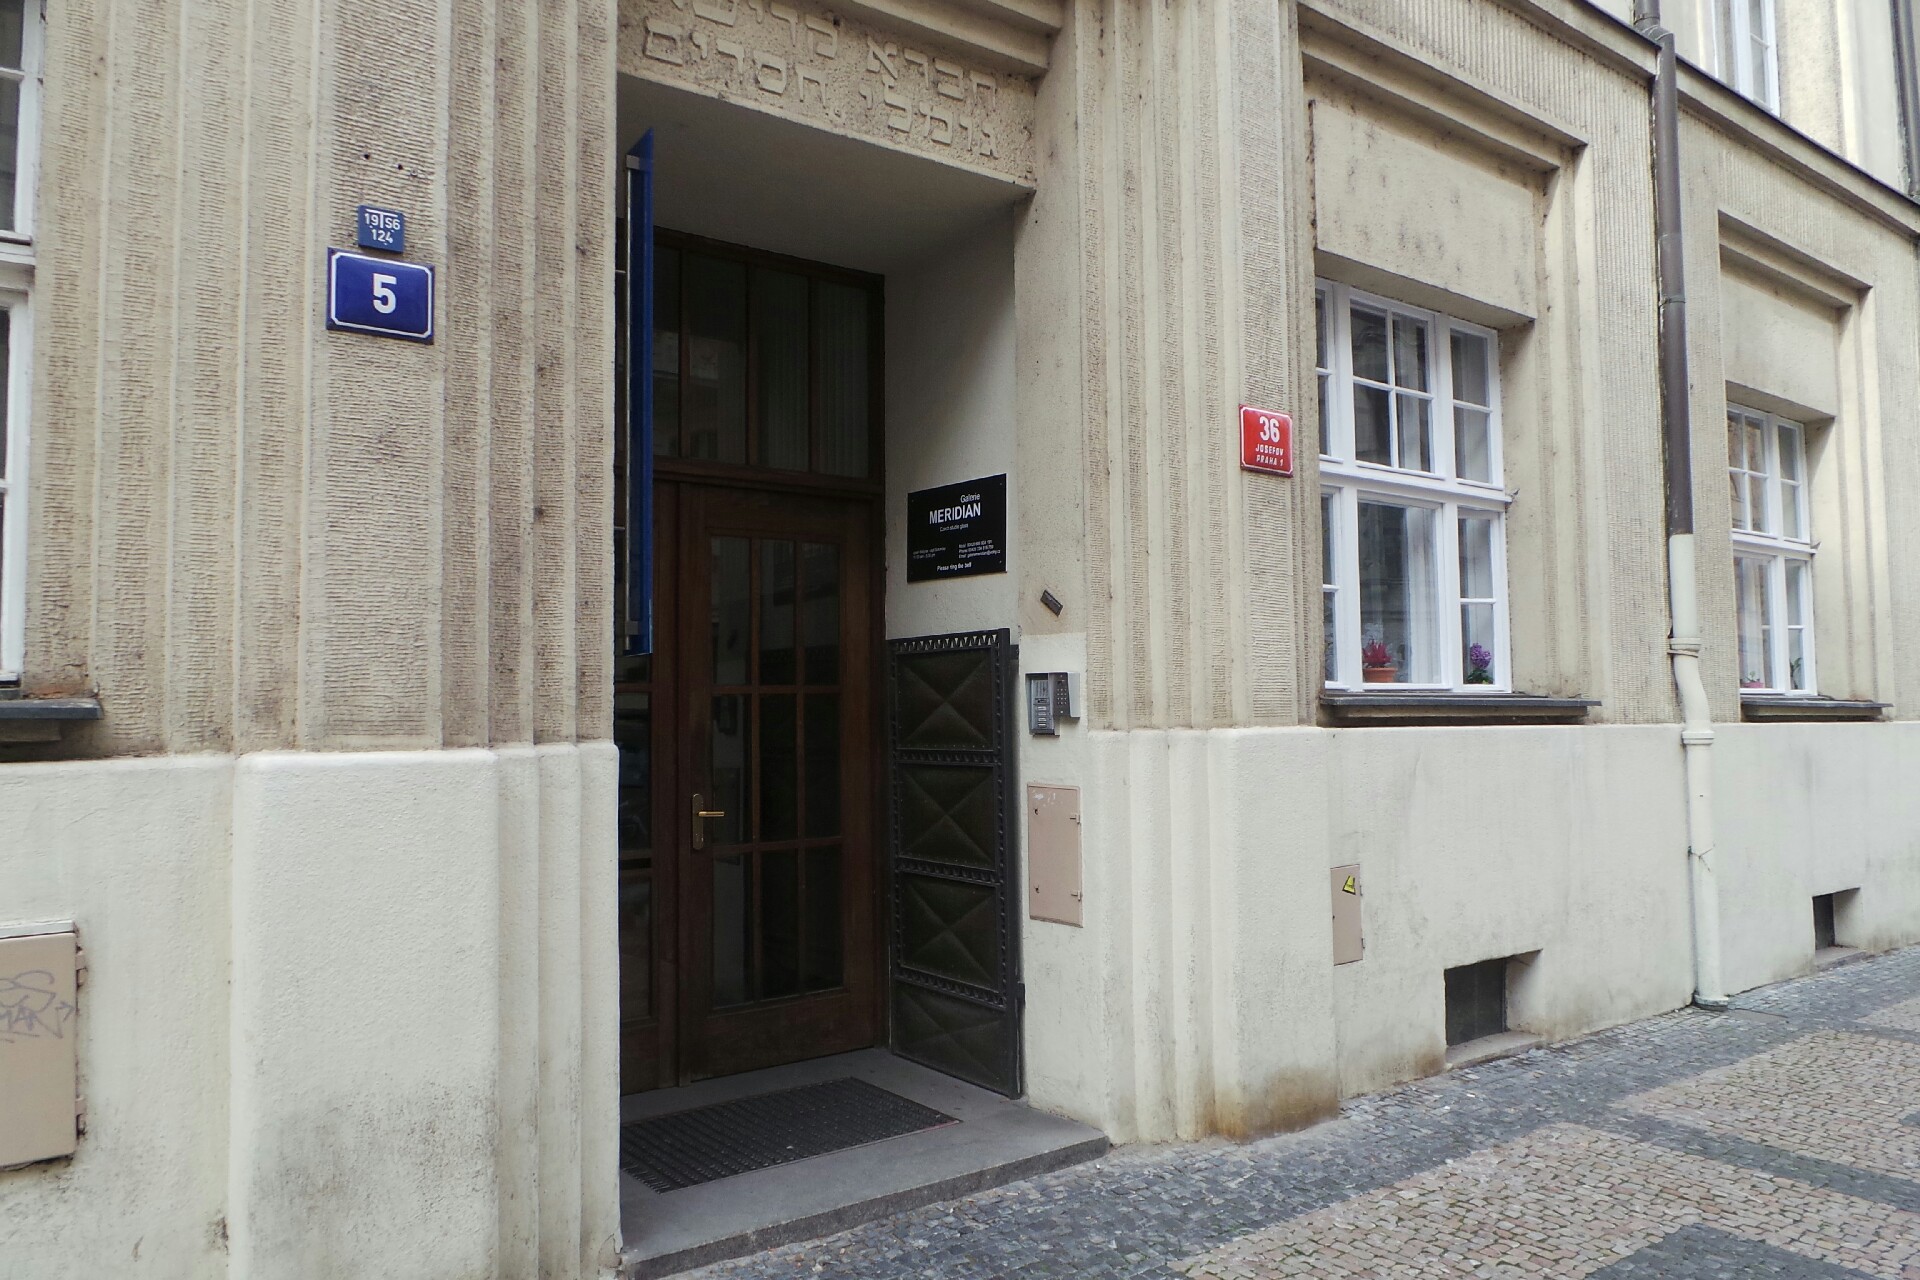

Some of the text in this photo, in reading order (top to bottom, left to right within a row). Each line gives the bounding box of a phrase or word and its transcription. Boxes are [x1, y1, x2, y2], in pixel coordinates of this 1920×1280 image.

[670, 0, 838, 62] קדיש
[371, 229, 393, 243] 124
[373, 273, 397, 314] 5
[1259, 416, 1280, 442] 36
[1255, 443, 1284, 456] JOSEFOV
[1256, 454, 1284, 467] PRAHA 1
[960, 493, 980, 503] Galerie
[929, 502, 981, 525] MERIDIAN
